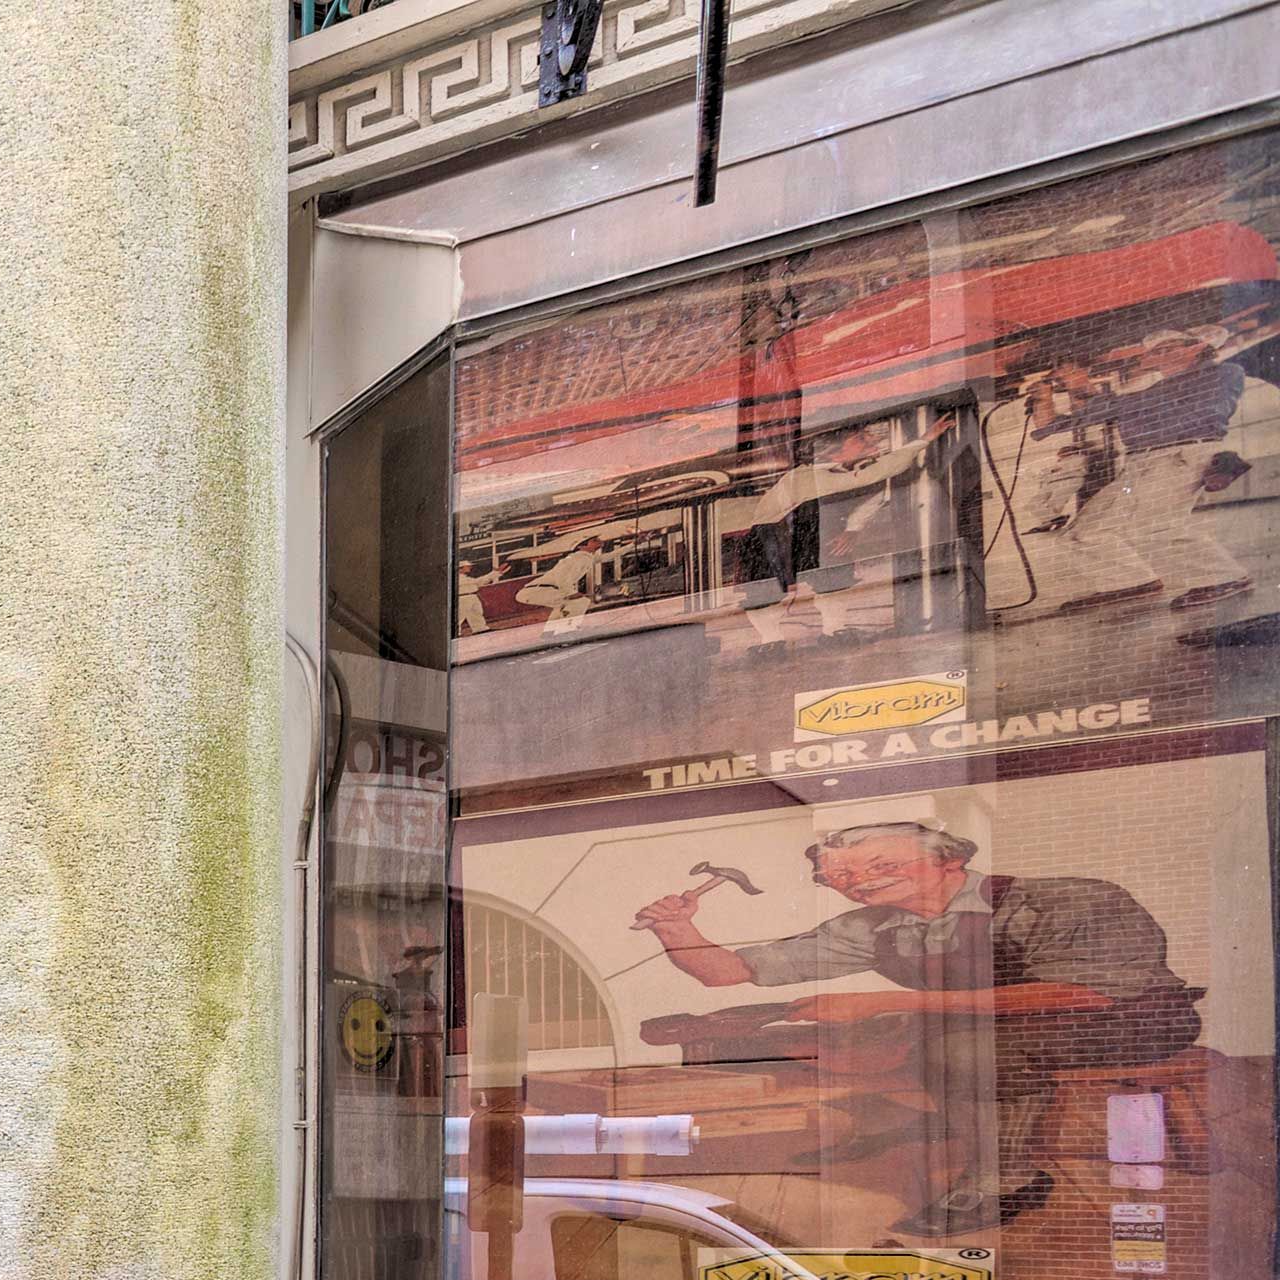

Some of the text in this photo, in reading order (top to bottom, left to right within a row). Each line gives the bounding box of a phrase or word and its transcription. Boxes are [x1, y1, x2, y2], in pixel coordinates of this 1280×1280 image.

[643, 697, 1151, 790] TIME FOR A CHANGE
